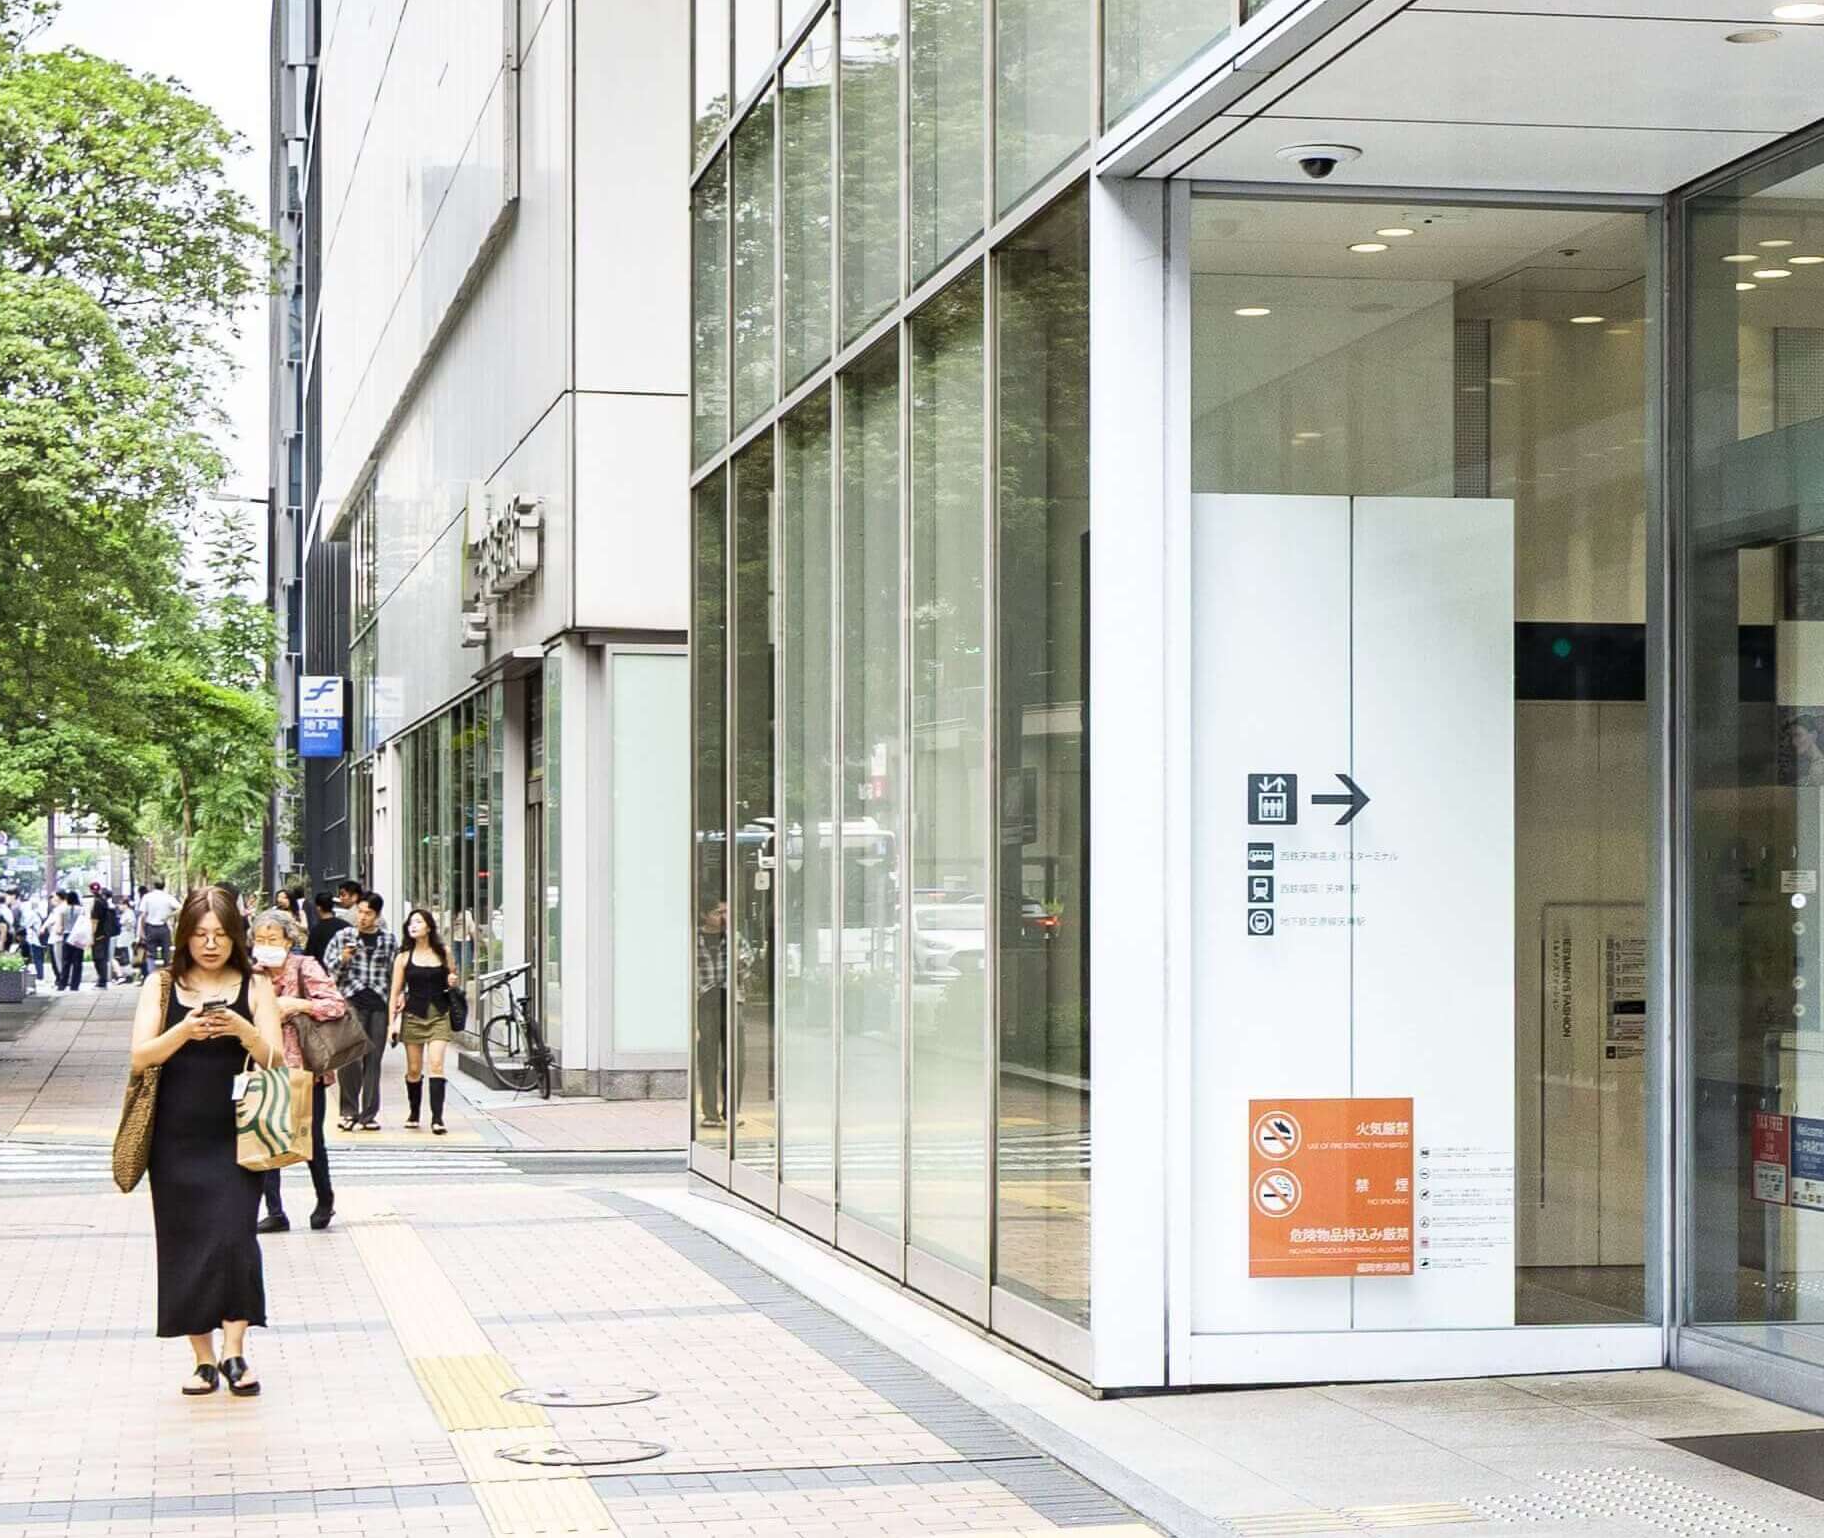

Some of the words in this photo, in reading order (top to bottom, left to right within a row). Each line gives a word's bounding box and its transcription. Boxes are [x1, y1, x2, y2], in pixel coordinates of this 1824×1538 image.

[1355, 1121, 1409, 1136] 火気厳禁
[1289, 1227, 1409, 1244] 危険物品持込み厳禁
